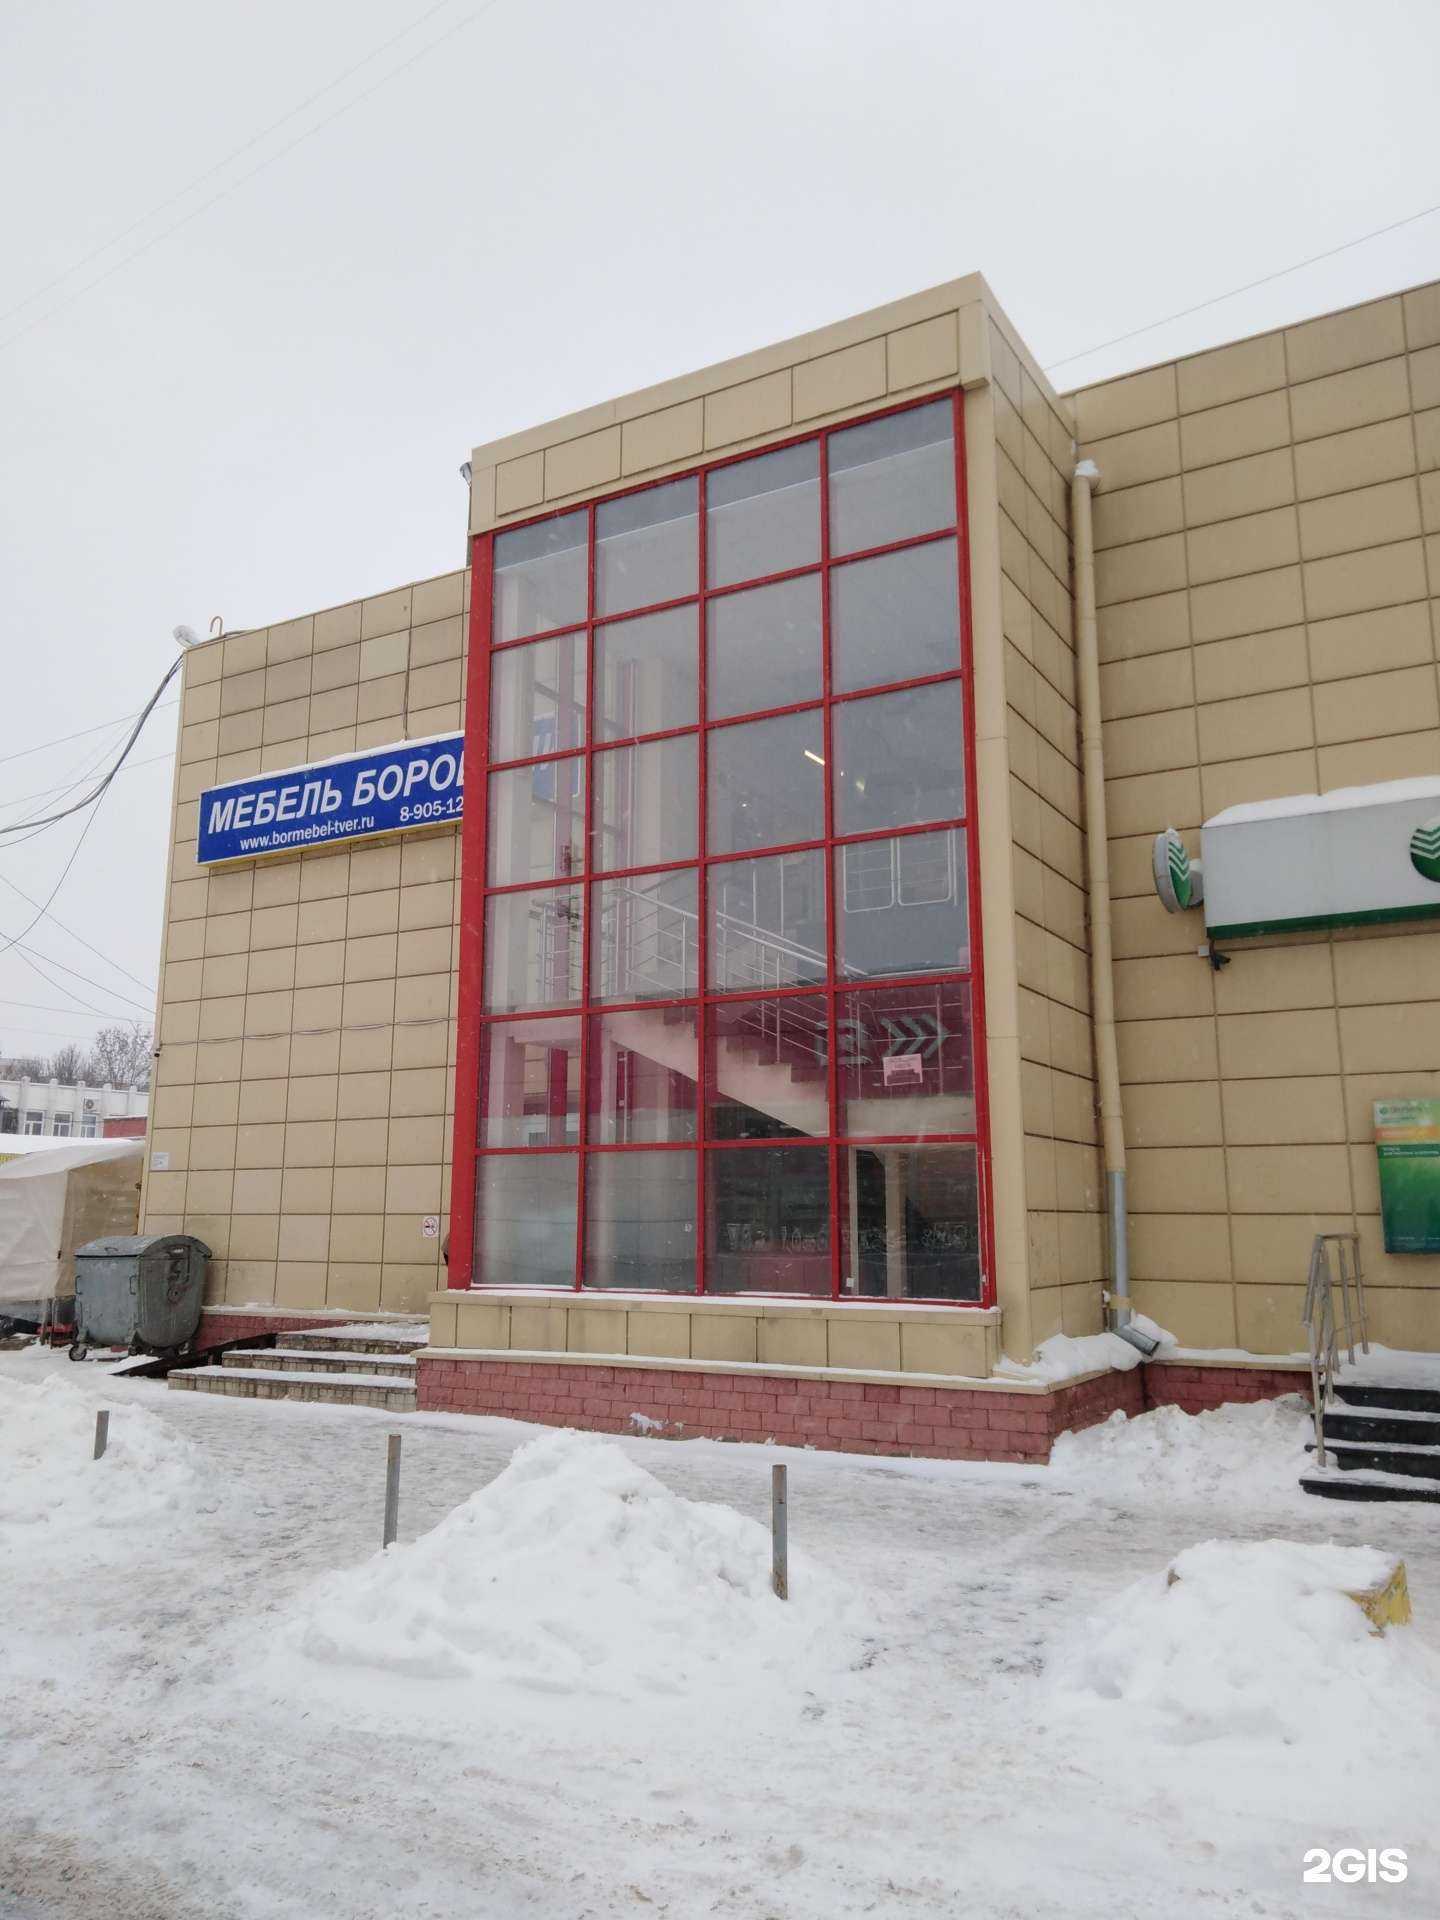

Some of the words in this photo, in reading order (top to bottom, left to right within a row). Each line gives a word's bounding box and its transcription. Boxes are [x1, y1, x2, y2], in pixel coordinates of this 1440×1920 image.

[208, 779, 342, 834] МЕБЕЛЬ
[400, 796, 464, 821] 8-905-12
[240, 814, 375, 851] www.bormebel-tver.ru
